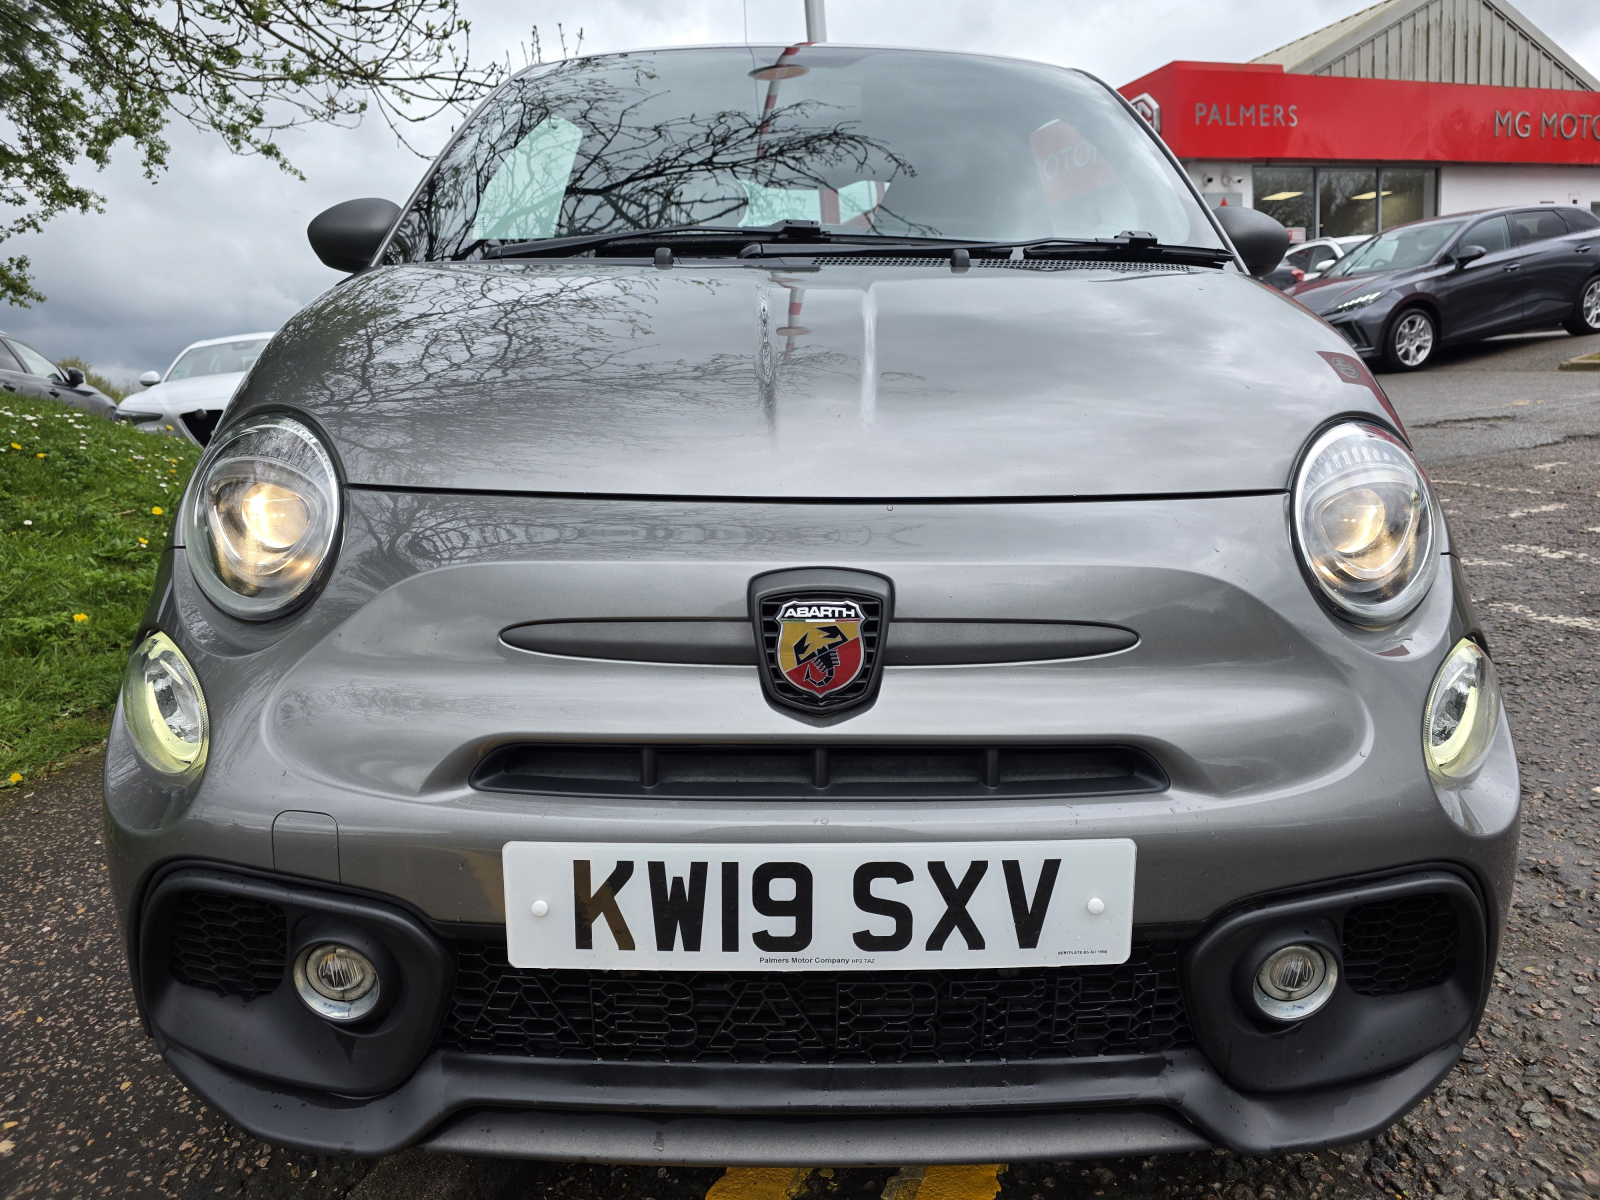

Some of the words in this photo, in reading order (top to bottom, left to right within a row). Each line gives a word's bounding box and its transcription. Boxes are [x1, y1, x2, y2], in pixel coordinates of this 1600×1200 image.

[1195, 102, 1298, 127] PALMERS
[1494, 110, 1531, 138] MG
[784, 606, 855, 618] ABARTH
[572, 859, 814, 953] KW19
[852, 858, 1062, 952] SXV
[814, 957, 850, 965] Company
[469, 973, 1160, 1050] ABARTH
